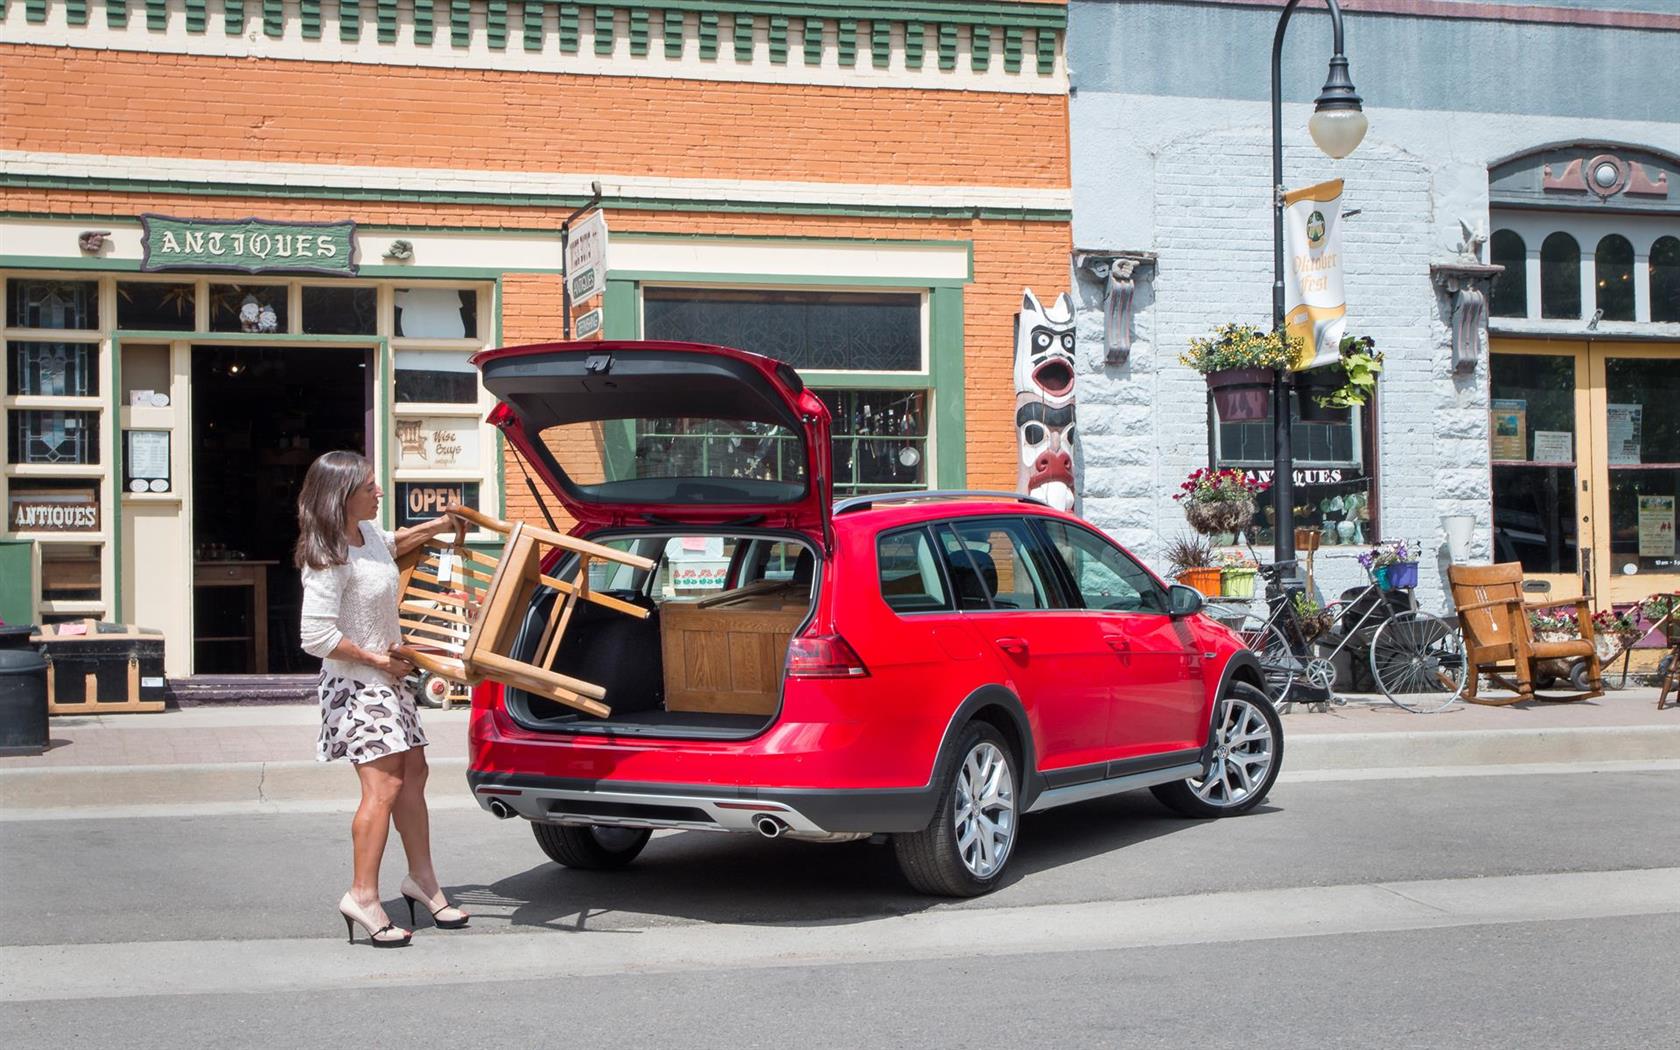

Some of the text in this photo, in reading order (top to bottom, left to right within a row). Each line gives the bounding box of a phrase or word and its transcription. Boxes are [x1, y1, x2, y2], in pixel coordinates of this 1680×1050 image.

[161, 230, 337, 259] ANTIQUES
[433, 430, 456, 443] Wise
[1245, 469, 1341, 487] ANQUES
[409, 487, 461, 513] OPEN
[15, 504, 96, 528] ANTIQUES
